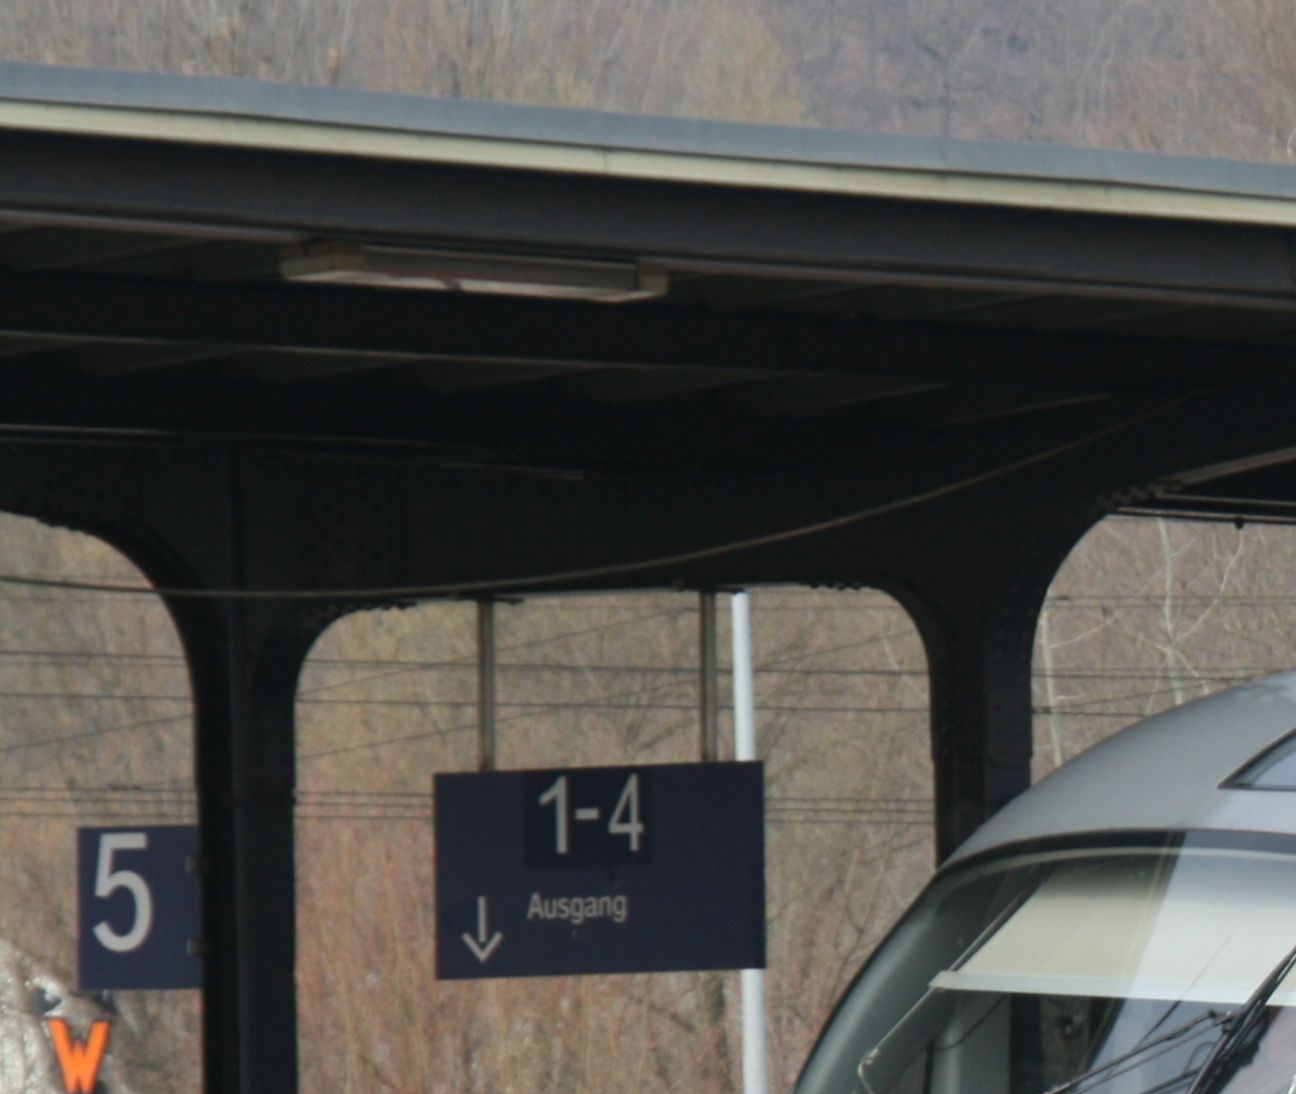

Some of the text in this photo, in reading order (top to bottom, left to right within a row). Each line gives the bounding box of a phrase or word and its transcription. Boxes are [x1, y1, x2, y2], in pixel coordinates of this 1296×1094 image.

[538, 774, 645, 854] 1-4
[93, 832, 153, 952] 5
[526, 892, 628, 925] Ausgang
[49, 1019, 110, 1094] W
